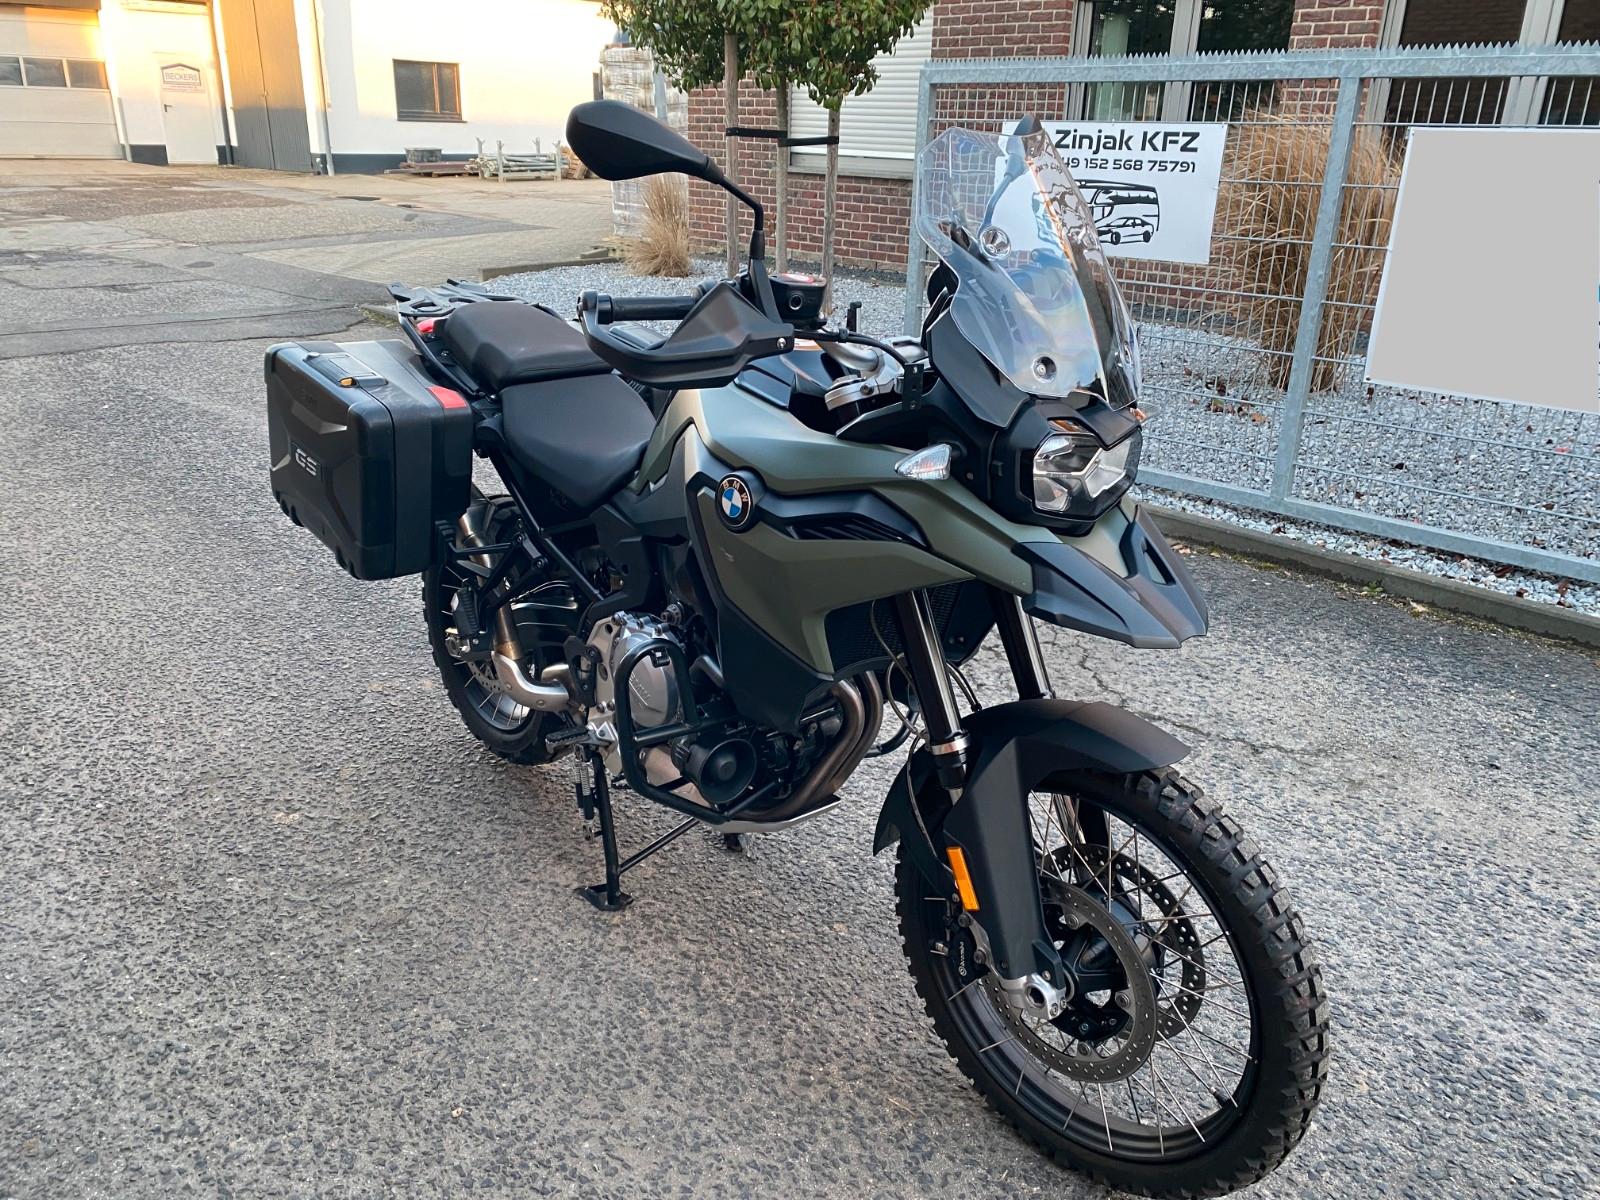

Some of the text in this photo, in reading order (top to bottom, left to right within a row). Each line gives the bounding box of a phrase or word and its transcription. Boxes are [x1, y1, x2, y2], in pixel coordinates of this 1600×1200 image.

[1055, 129, 1200, 155] Zinjak KFZ
[1084, 158, 1109, 170] 152
[1112, 159, 1143, 171] 568
[1148, 160, 1196, 173] 75791
[295, 448, 317, 476] GS
[722, 480, 749, 502] BMW
